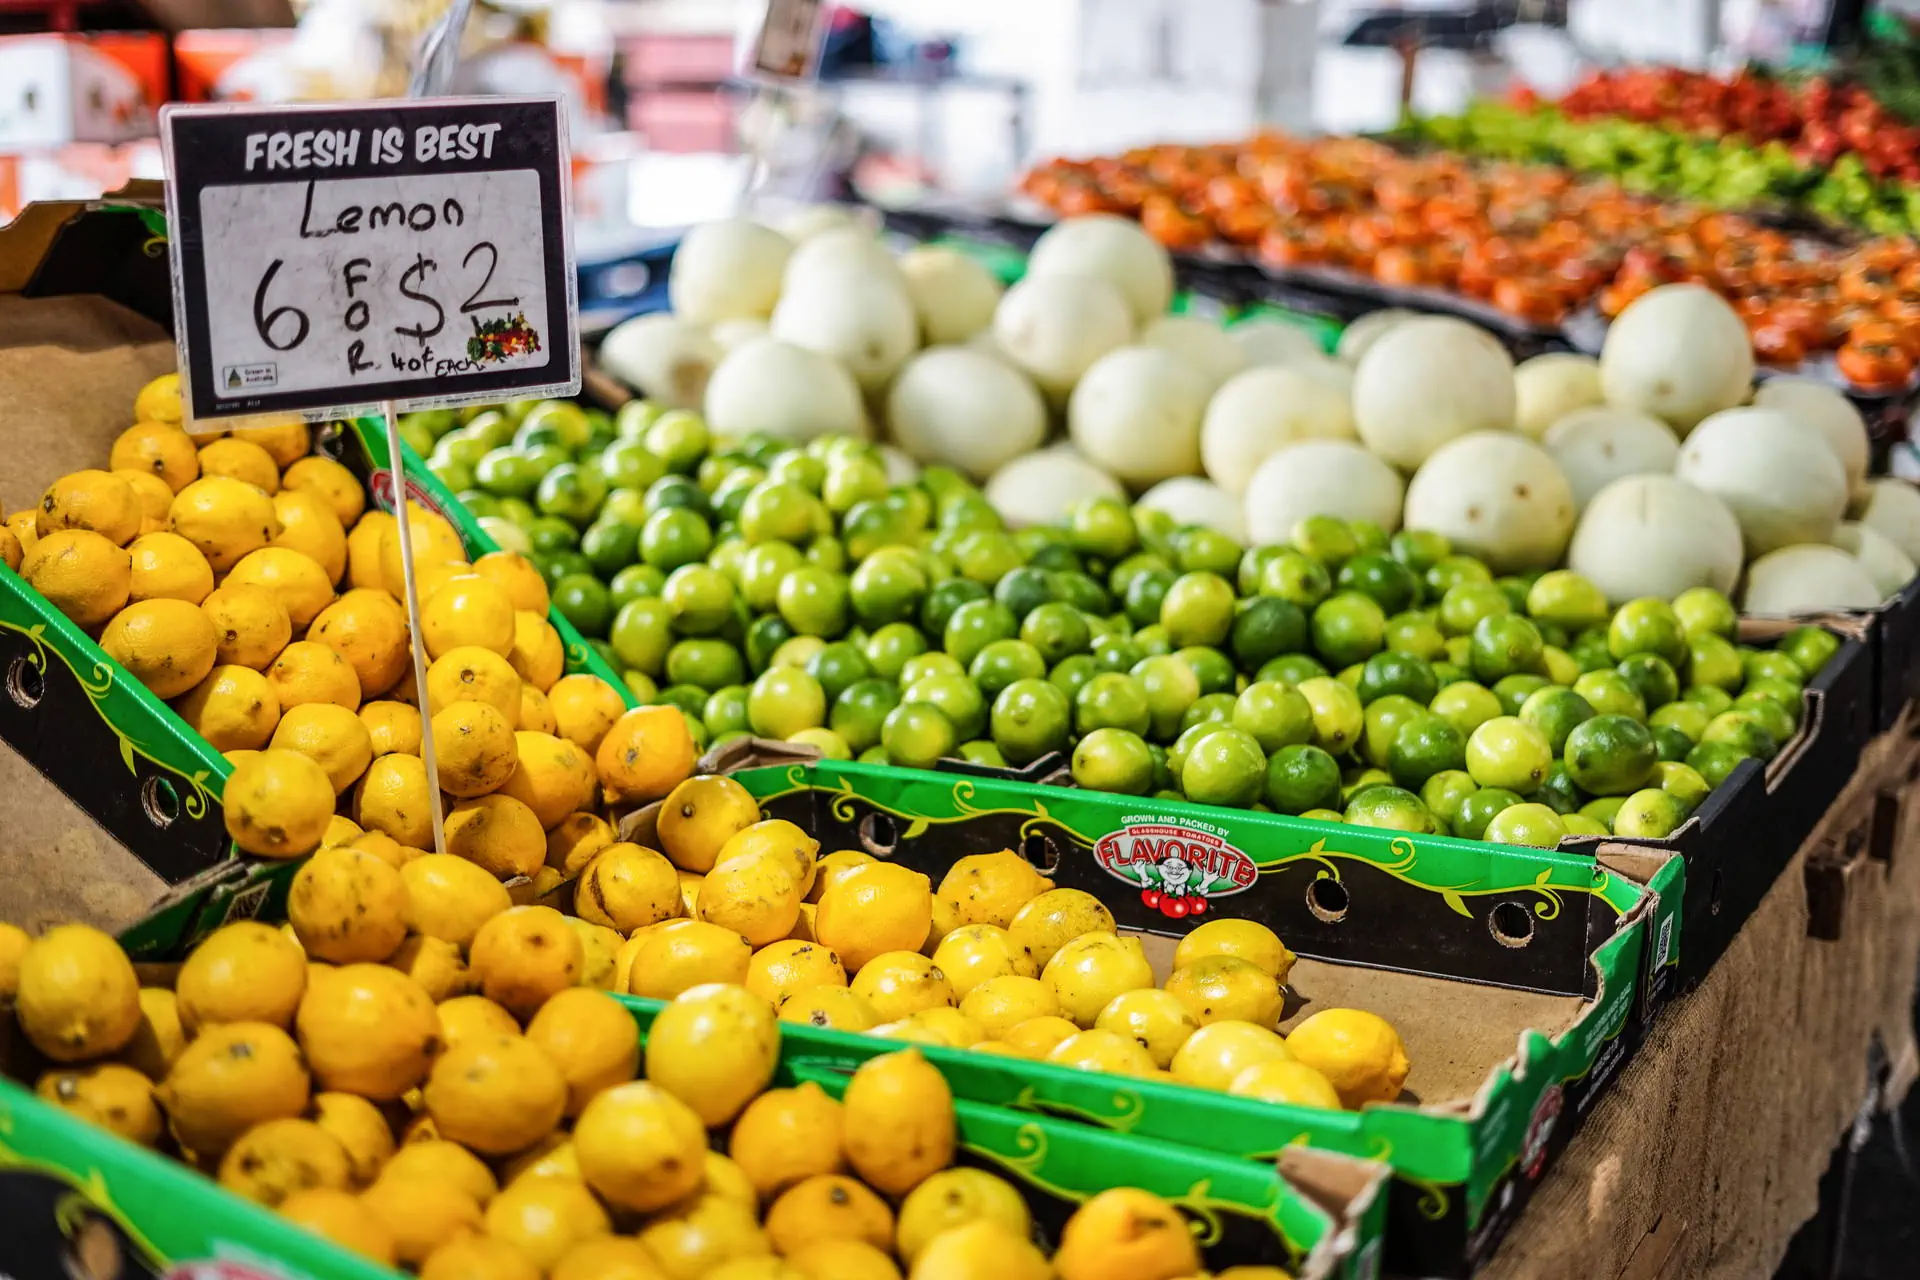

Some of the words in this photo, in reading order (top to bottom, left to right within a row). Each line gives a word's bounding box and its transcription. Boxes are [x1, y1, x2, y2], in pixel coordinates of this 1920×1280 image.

[245, 129, 361, 171] FRESH
[370, 126, 405, 164] IS
[415, 123, 501, 163] BEST
[300, 178, 464, 238] Lemon
[253, 258, 310, 351] 6
[1121, 815, 1155, 824] GROWN
[1157, 816, 1176, 824] AND
[1179, 817, 1215, 832] PACKED
[1217, 827, 1230, 837] BY
[1131, 827, 1177, 836] GLASSHOUSE
[1182, 830, 1219, 846] TOMATOES
[1097, 838, 1254, 887] FLAVORITE
